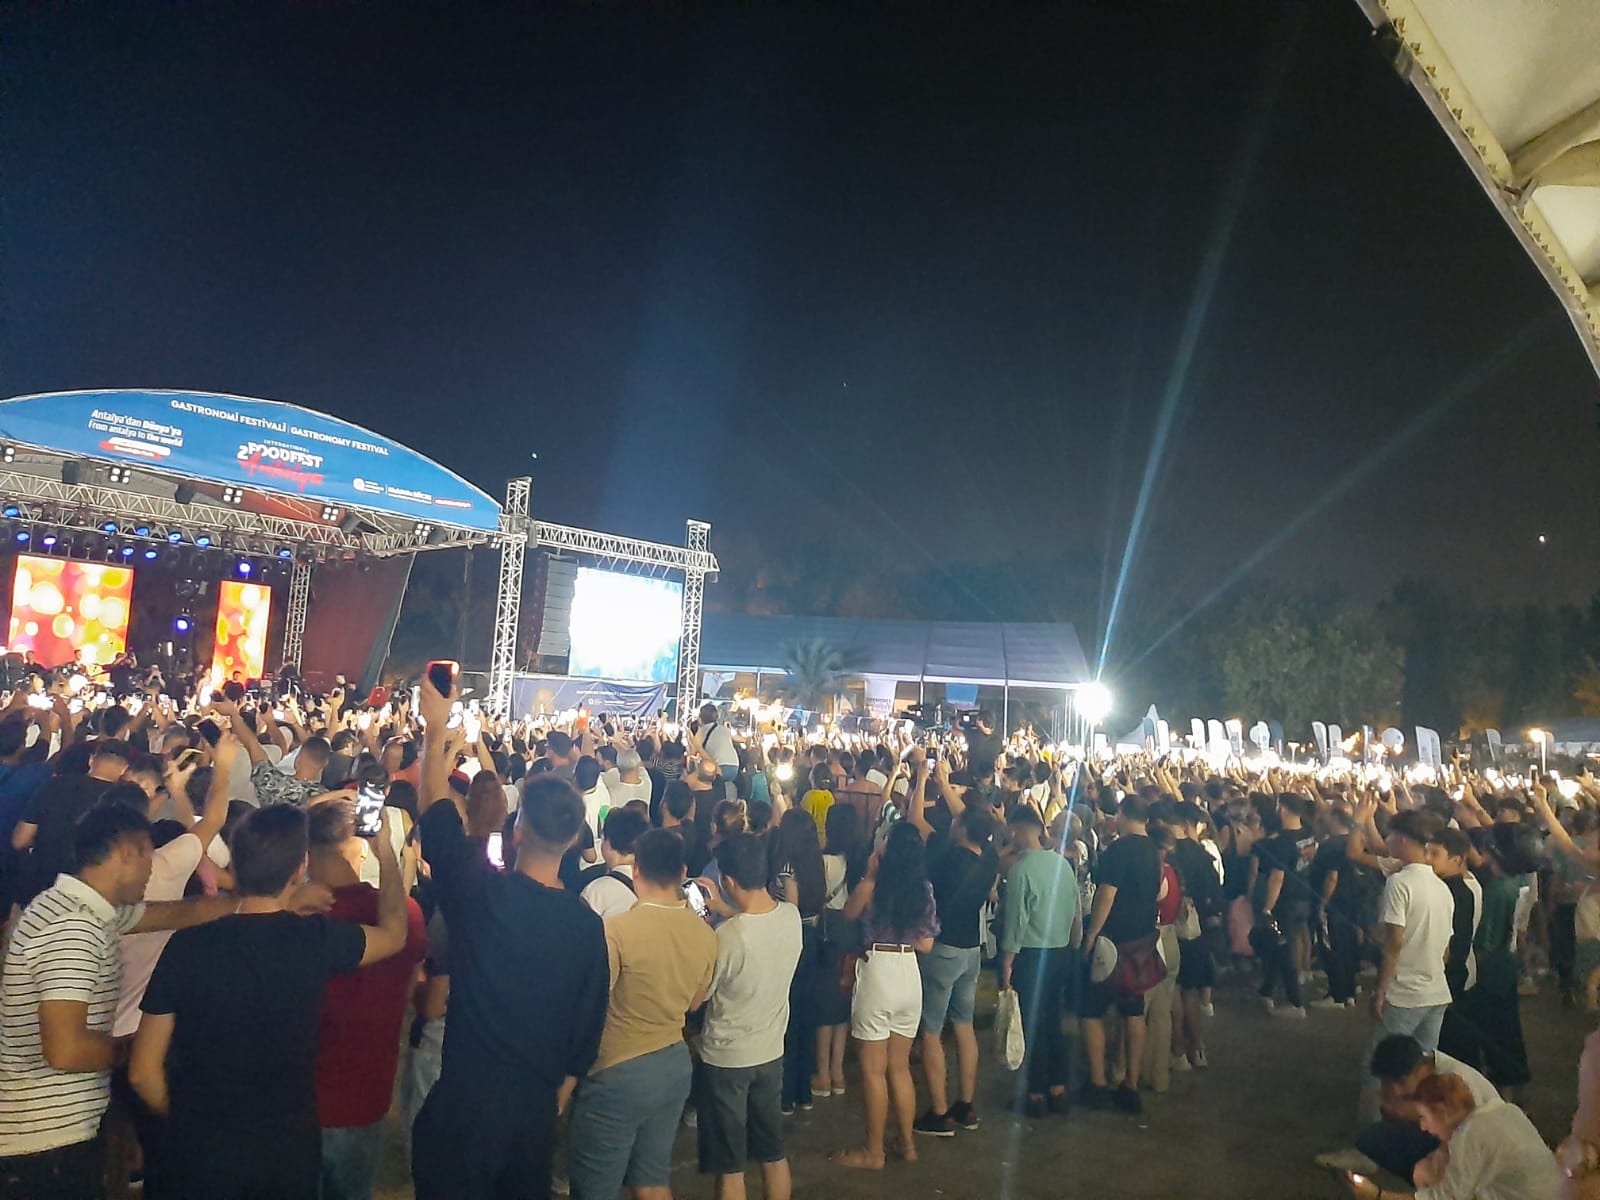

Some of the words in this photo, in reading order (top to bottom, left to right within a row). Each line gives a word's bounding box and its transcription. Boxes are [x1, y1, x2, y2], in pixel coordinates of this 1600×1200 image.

[88, 420, 108, 431] From
[137, 430, 146, 440] to
[170, 399, 239, 423] GASTRONOMİ
[290, 426, 352, 448] GASTRONOMY
[351, 440, 390, 456] FESTIVAL
